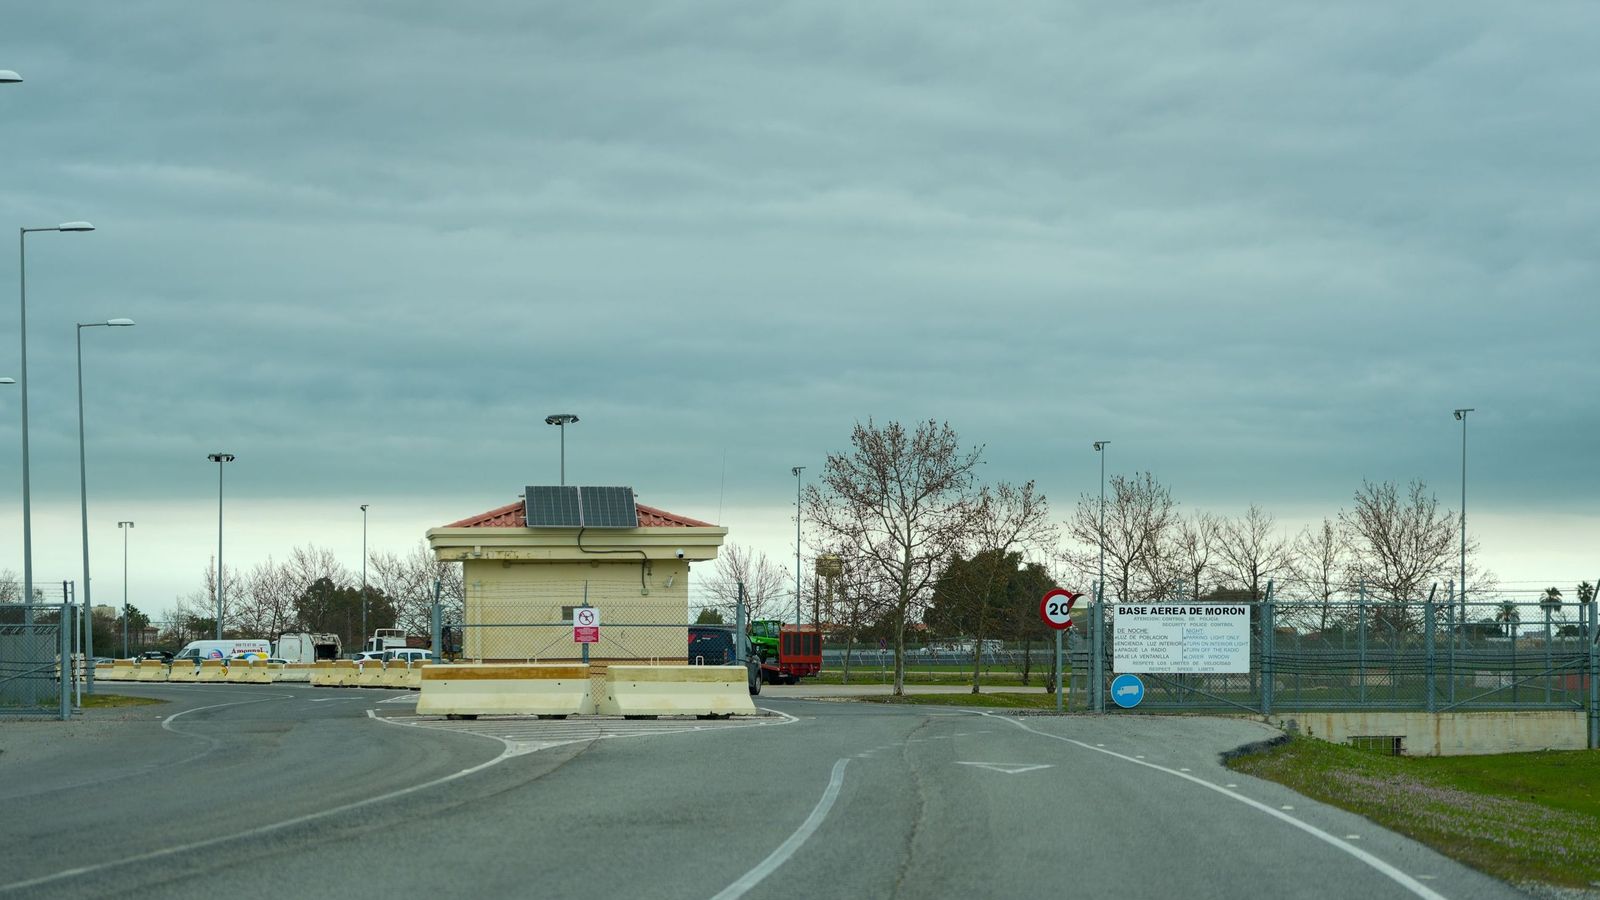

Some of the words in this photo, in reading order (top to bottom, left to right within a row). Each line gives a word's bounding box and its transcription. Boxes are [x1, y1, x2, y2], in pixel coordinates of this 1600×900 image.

[1049, 603, 1070, 616] 20
[1119, 607, 1147, 615] BASE
[1190, 607, 1202, 615] DE
